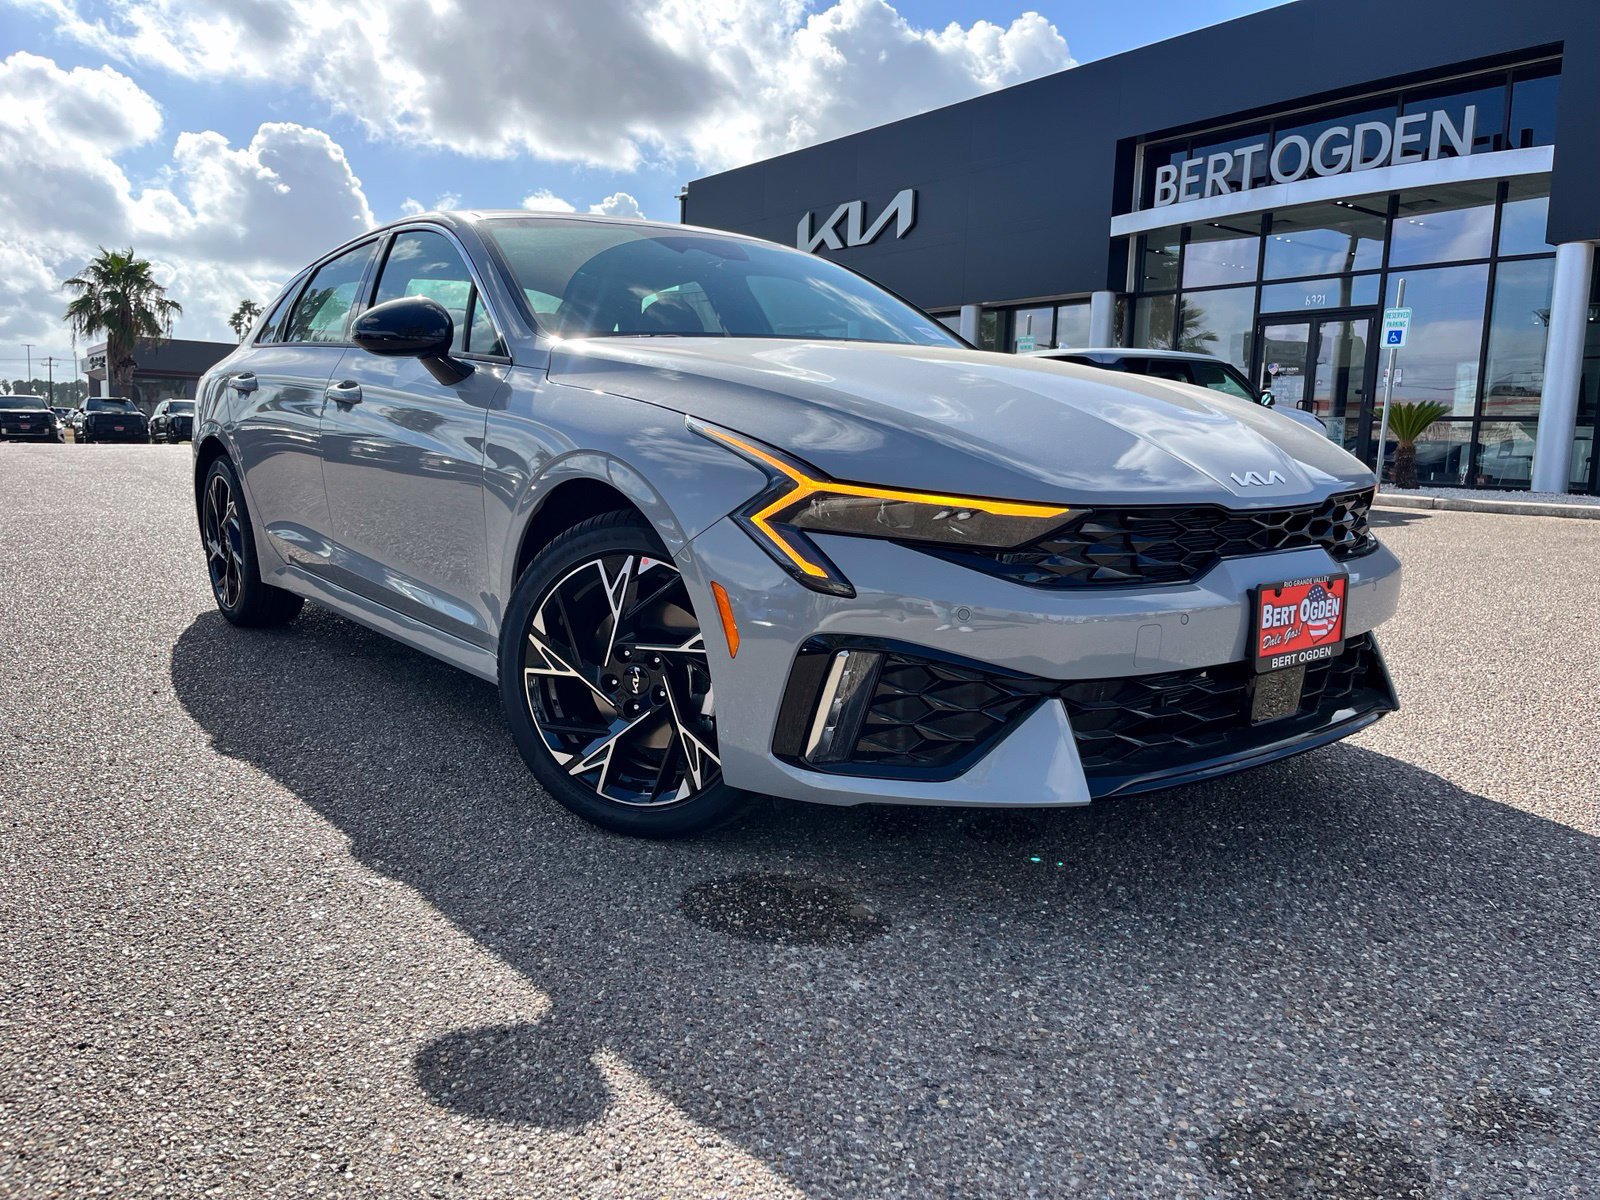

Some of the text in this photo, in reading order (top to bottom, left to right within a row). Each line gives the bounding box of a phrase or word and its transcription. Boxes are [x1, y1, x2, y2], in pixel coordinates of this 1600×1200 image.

[1154, 105, 1476, 207] BERT OGDEN
[796, 188, 914, 254] KIA
[1293, 578, 1313, 586] GRANDE
[1313, 575, 1330, 583] VALLEY
[1261, 598, 1340, 628] BERT OGDEN
[1272, 647, 1332, 668] BERT OGDEN
